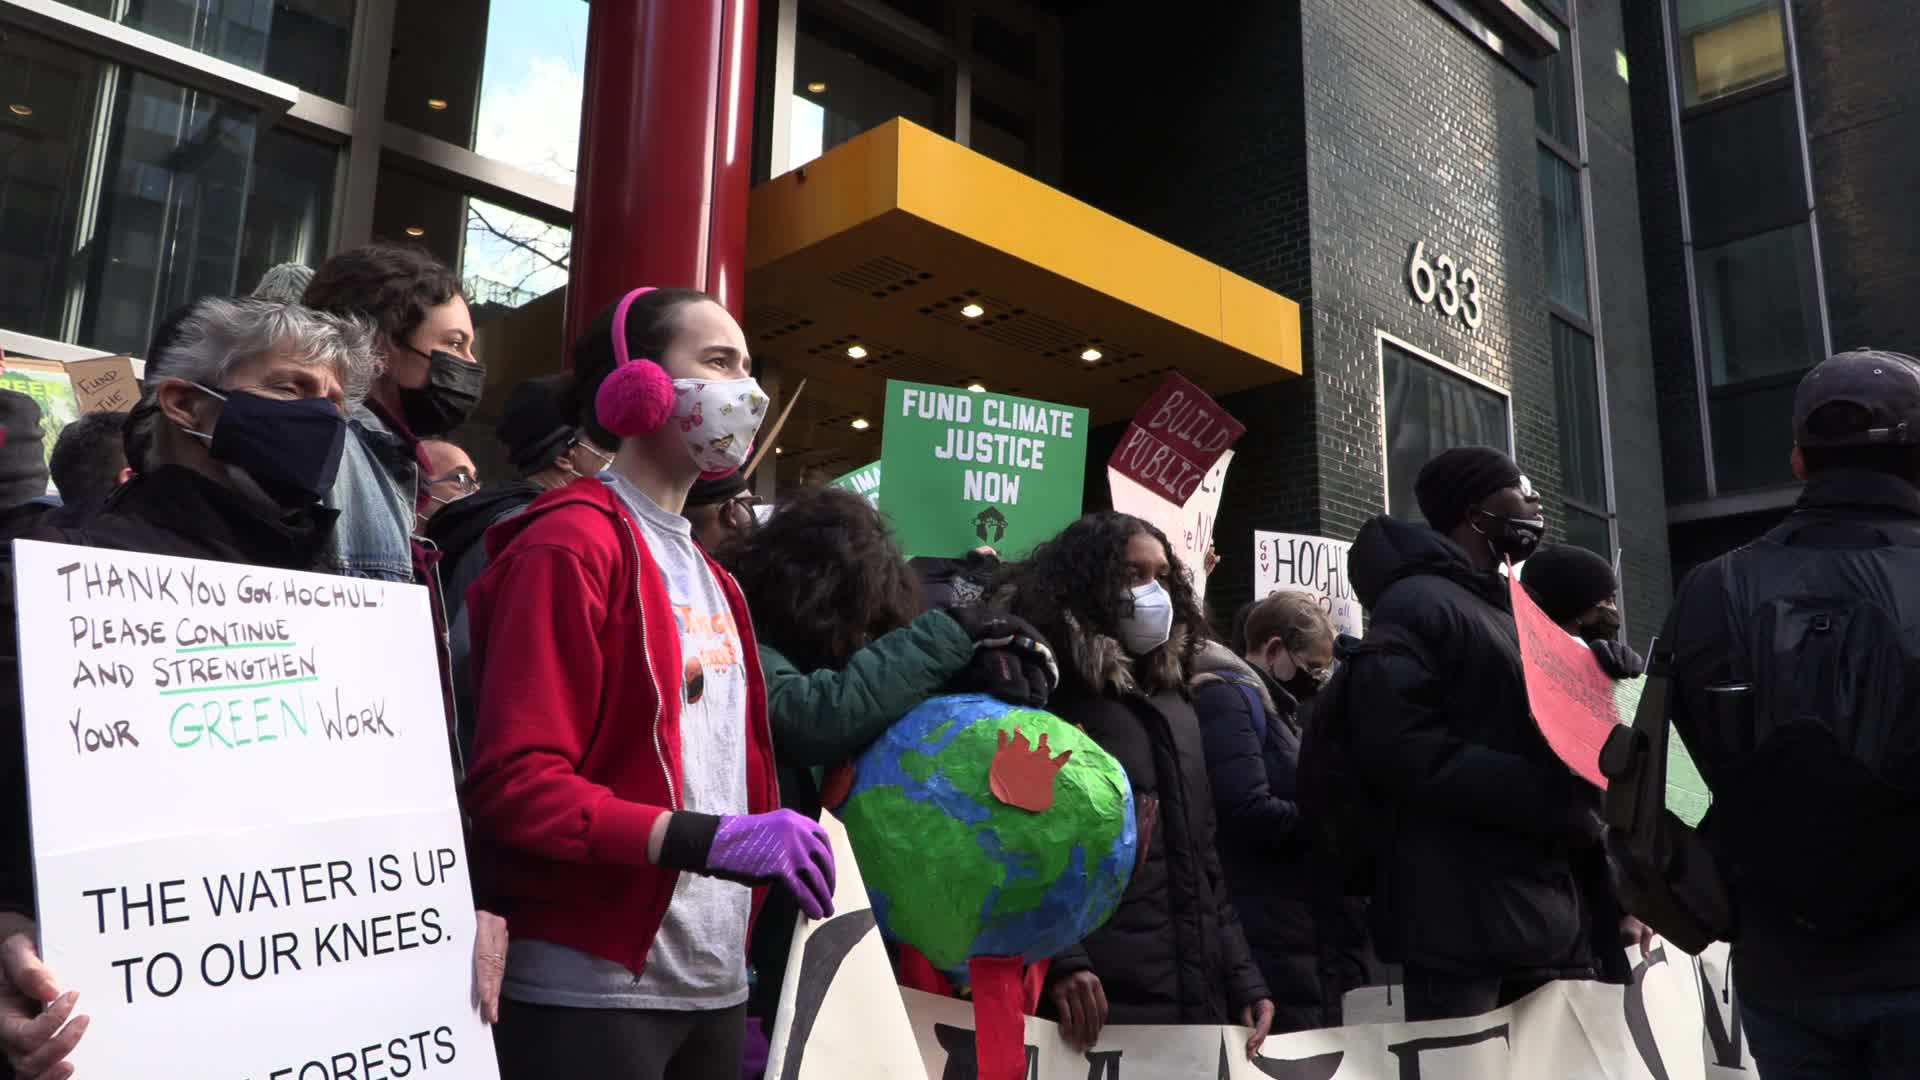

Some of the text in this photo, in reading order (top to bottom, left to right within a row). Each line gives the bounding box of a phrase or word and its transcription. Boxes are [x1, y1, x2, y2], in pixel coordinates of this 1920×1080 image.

[1411, 240, 1482, 329] 633
[78, 370, 118, 394] FUND
[96, 390, 123, 411] THE
[903, 389, 1074, 438] FUND CLIMATE
[1149, 390, 1230, 450] BUILD
[935, 428, 1046, 471] JUSTICE
[1119, 427, 1202, 500] PUBLIC
[963, 469, 1020, 505] NOW
[57, 562, 178, 604] THANK
[181, 565, 226, 607] YOU
[284, 578, 384, 608] HOCHUL!
[69, 616, 290, 649] PLEASE CONTINUE
[73, 647, 316, 688] AND STRENGTHEN
[69, 708, 139, 754] YOUR
[169, 690, 307, 748] GREEN
[83, 848, 456, 933] THE WATER IS UP
[112, 907, 452, 1003] TO OUR KNEES.
